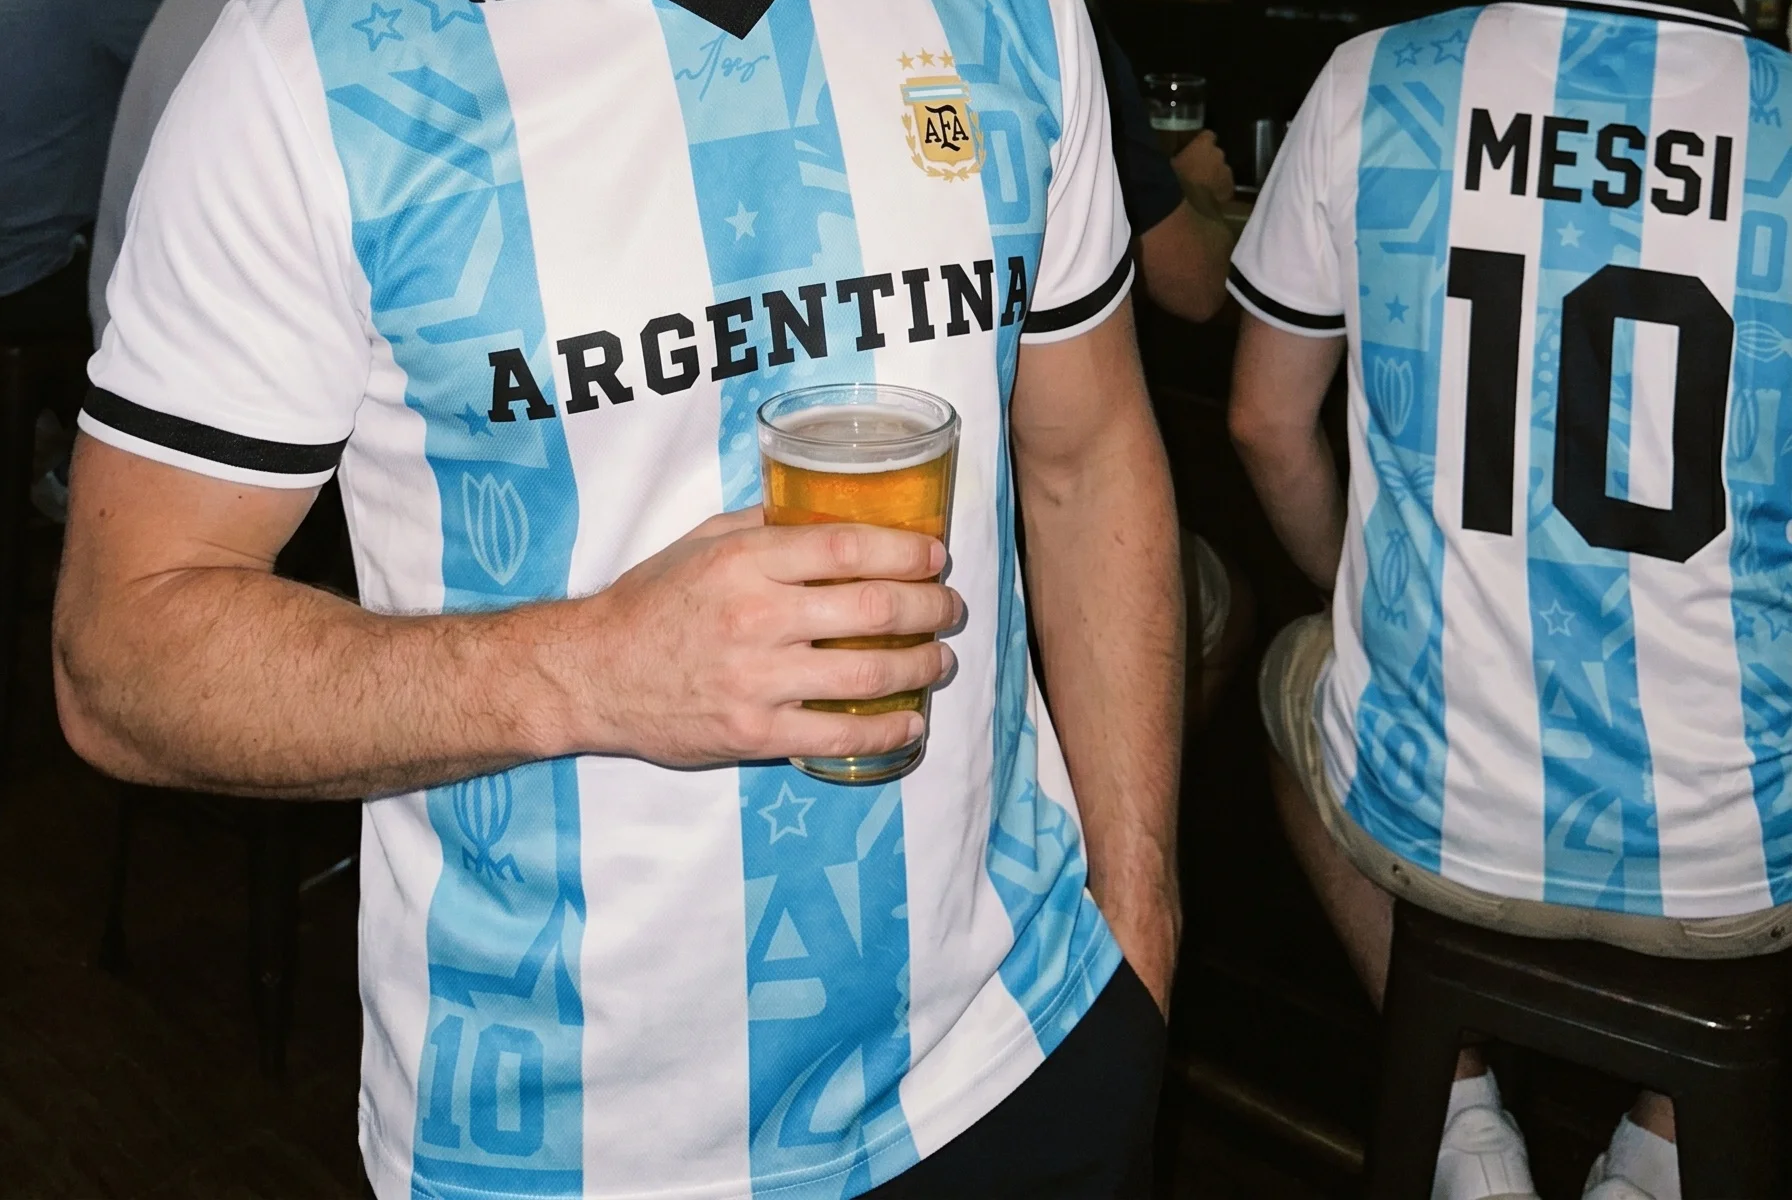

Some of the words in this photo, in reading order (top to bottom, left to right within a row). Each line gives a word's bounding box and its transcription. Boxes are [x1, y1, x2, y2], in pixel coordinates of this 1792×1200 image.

[925, 104, 970, 152] AFA
[1464, 107, 1733, 222] MESSI
[487, 255, 1029, 423] ARGENTINA
[1446, 246, 1735, 564] 10
[421, 1013, 546, 1156] 10
